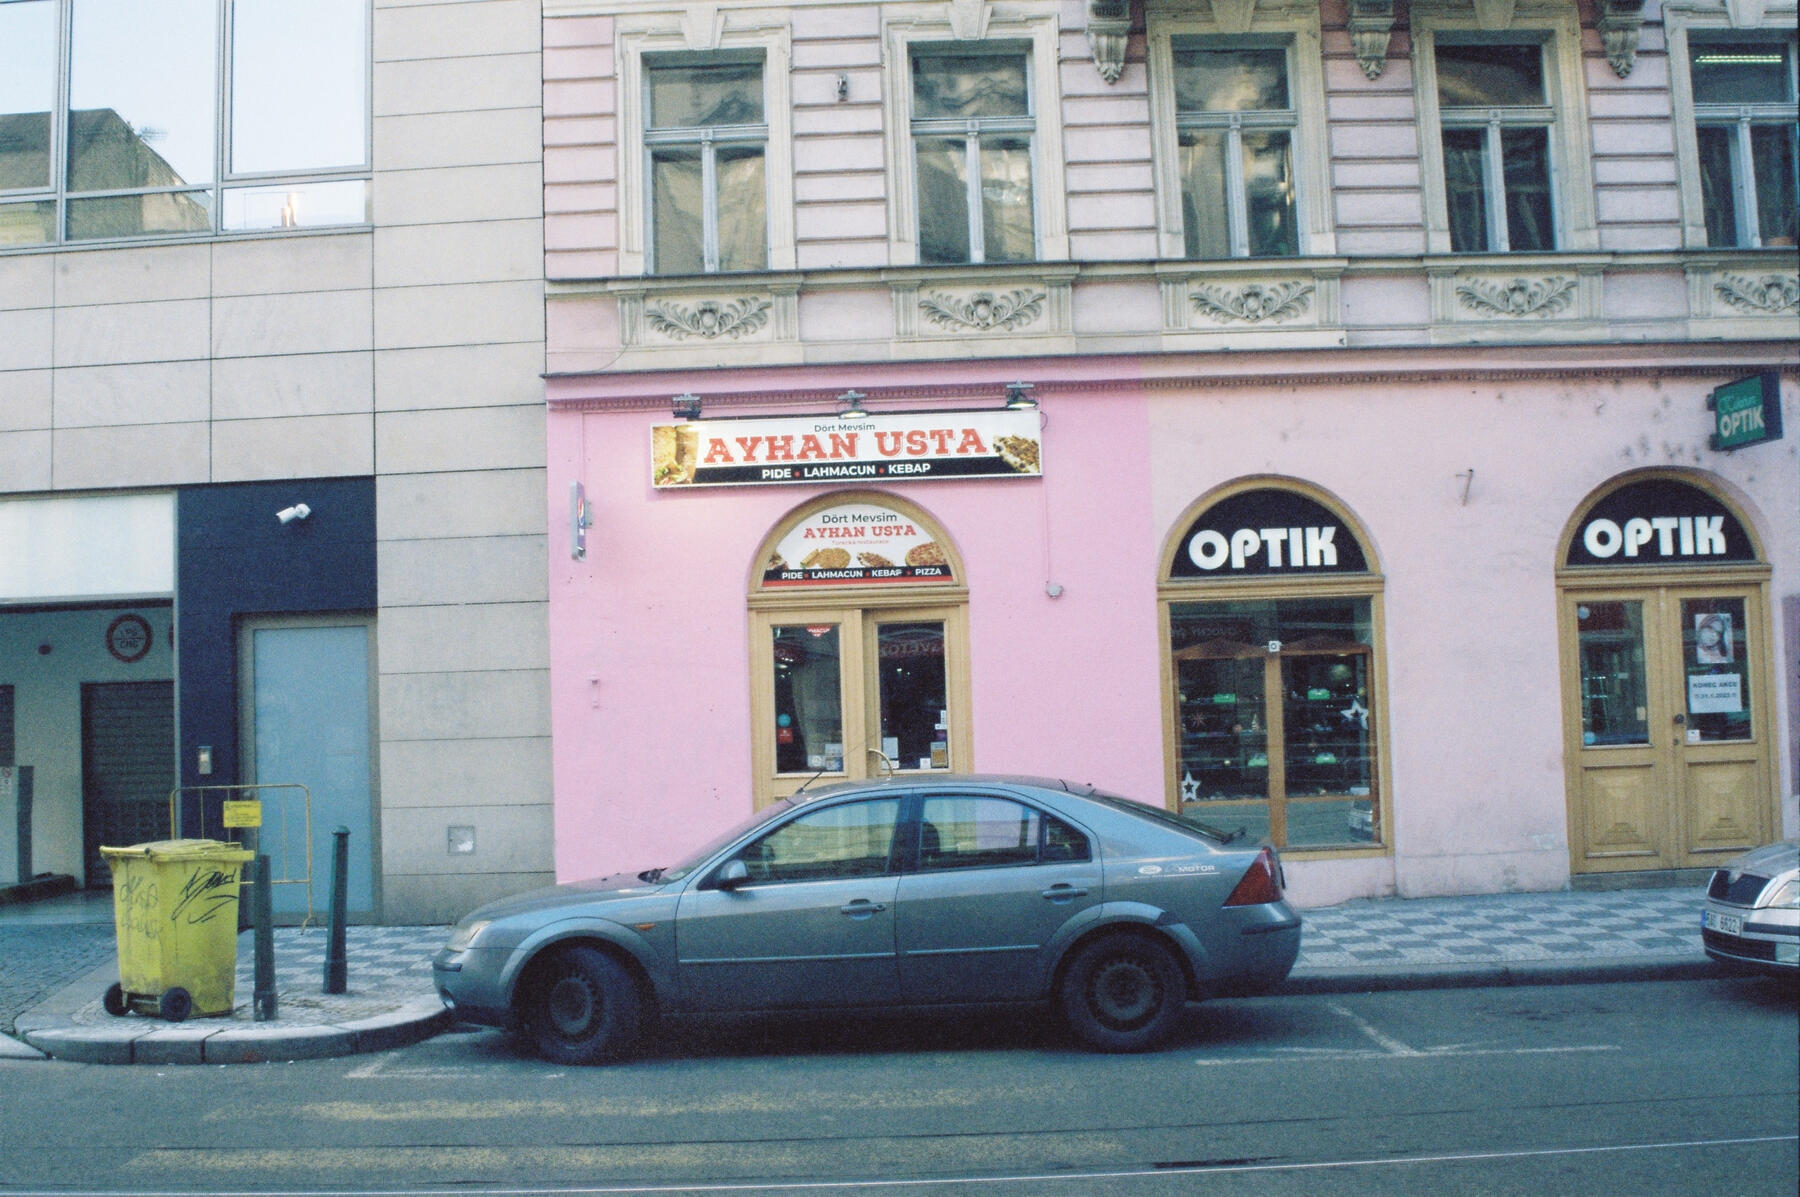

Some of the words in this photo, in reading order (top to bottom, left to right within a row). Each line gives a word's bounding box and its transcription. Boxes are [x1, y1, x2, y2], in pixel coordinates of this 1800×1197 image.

[814, 424, 835, 433] Dört
[838, 422, 876, 432] Mevsim
[1720, 404, 1766, 438] OPTIK
[703, 433, 859, 464] AYHAN
[874, 428, 988, 457] USTA
[761, 468, 792, 479] PIDE
[804, 465, 876, 478] LAHMACUN
[888, 463, 931, 474] KEBAP
[822, 513, 848, 524] Dört
[852, 512, 898, 523] Mevsim
[803, 526, 865, 539] AYHAN
[871, 525, 917, 537] USTA
[1583, 516, 1727, 559] OPTIK
[1188, 526, 1338, 570] OPTIK
[781, 571, 803, 580] PIDE
[811, 570, 863, 579] LAHMACUN
[871, 568, 902, 577] KEBAP
[915, 567, 942, 576] PIZZA
